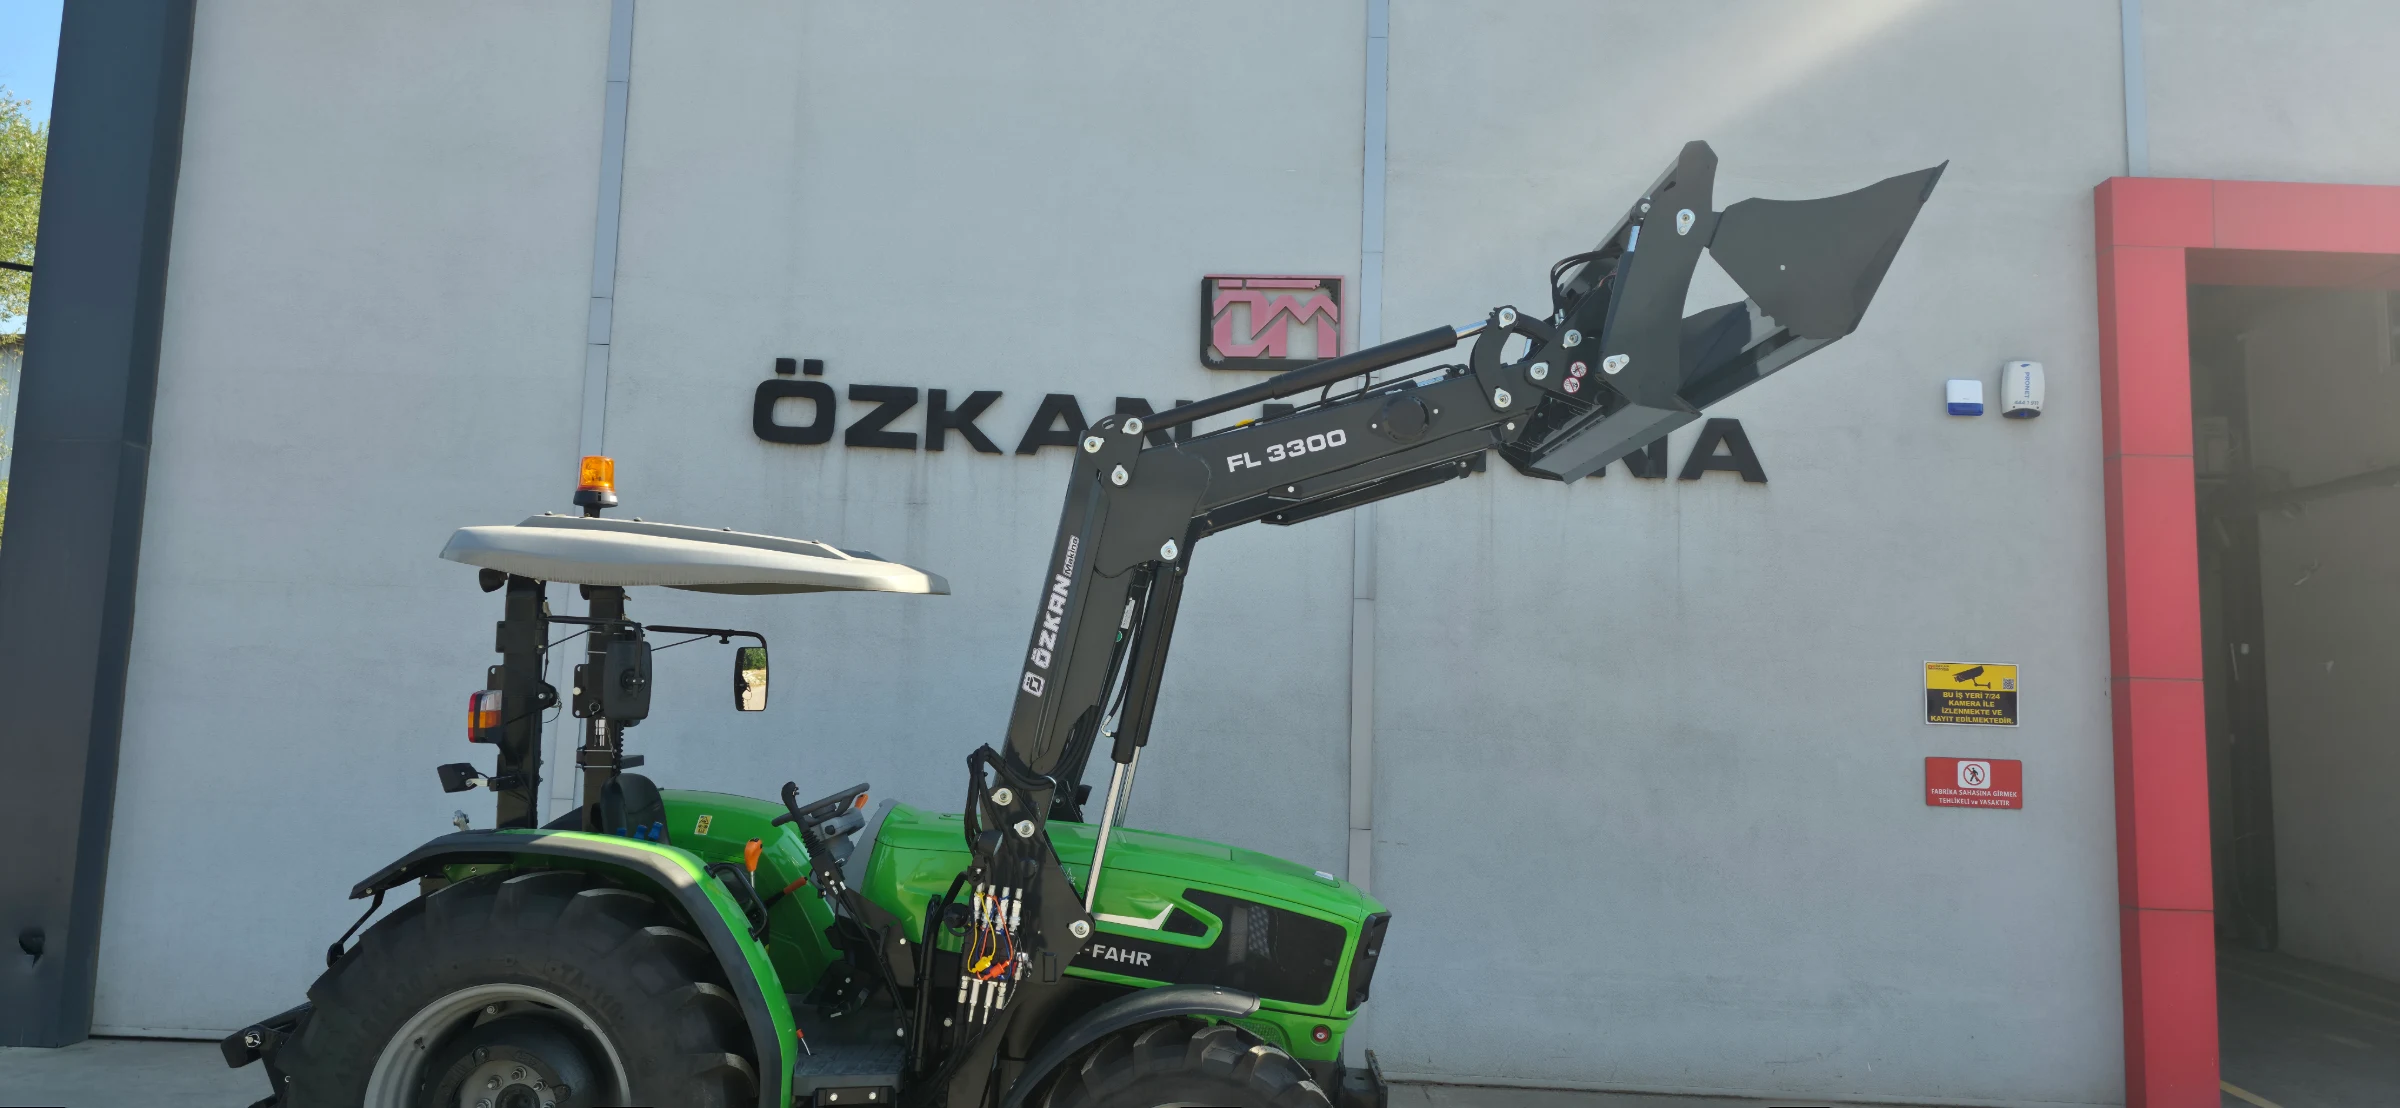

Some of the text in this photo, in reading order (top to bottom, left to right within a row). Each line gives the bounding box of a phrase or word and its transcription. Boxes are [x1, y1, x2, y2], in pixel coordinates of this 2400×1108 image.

[752, 357, 1194, 455] ÖZKAN
[1226, 429, 1347, 472] FL 3300
[1030, 574, 1072, 670] ÖZKAN
[1965, 691, 1983, 699] YERİ
[1941, 706, 1990, 715] İZLENMEKTE
[1982, 700, 1995, 708] İLE
[1931, 788, 1957, 796] FABRİKA
[1992, 790, 2018, 798] GİRMEK
[1077, 943, 1152, 967] -FAHR
